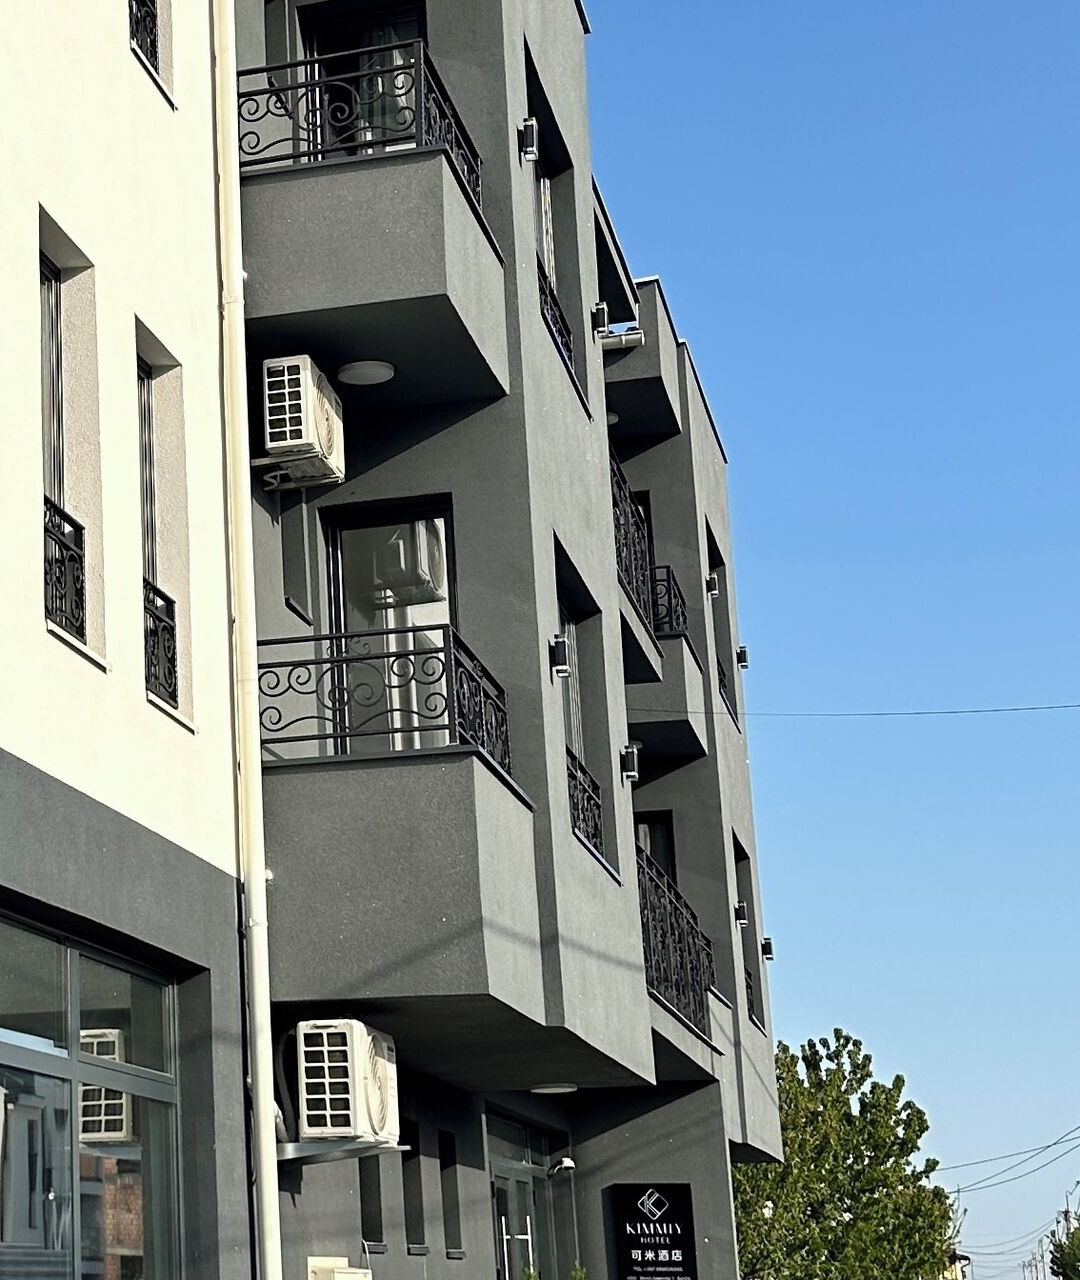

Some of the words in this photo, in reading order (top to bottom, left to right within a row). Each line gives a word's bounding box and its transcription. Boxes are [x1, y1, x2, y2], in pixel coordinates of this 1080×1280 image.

[626, 1222, 682, 1234] KIMMIY
[640, 1236, 671, 1244] HOTEL
[631, 1249, 683, 1261] 可米酒店
